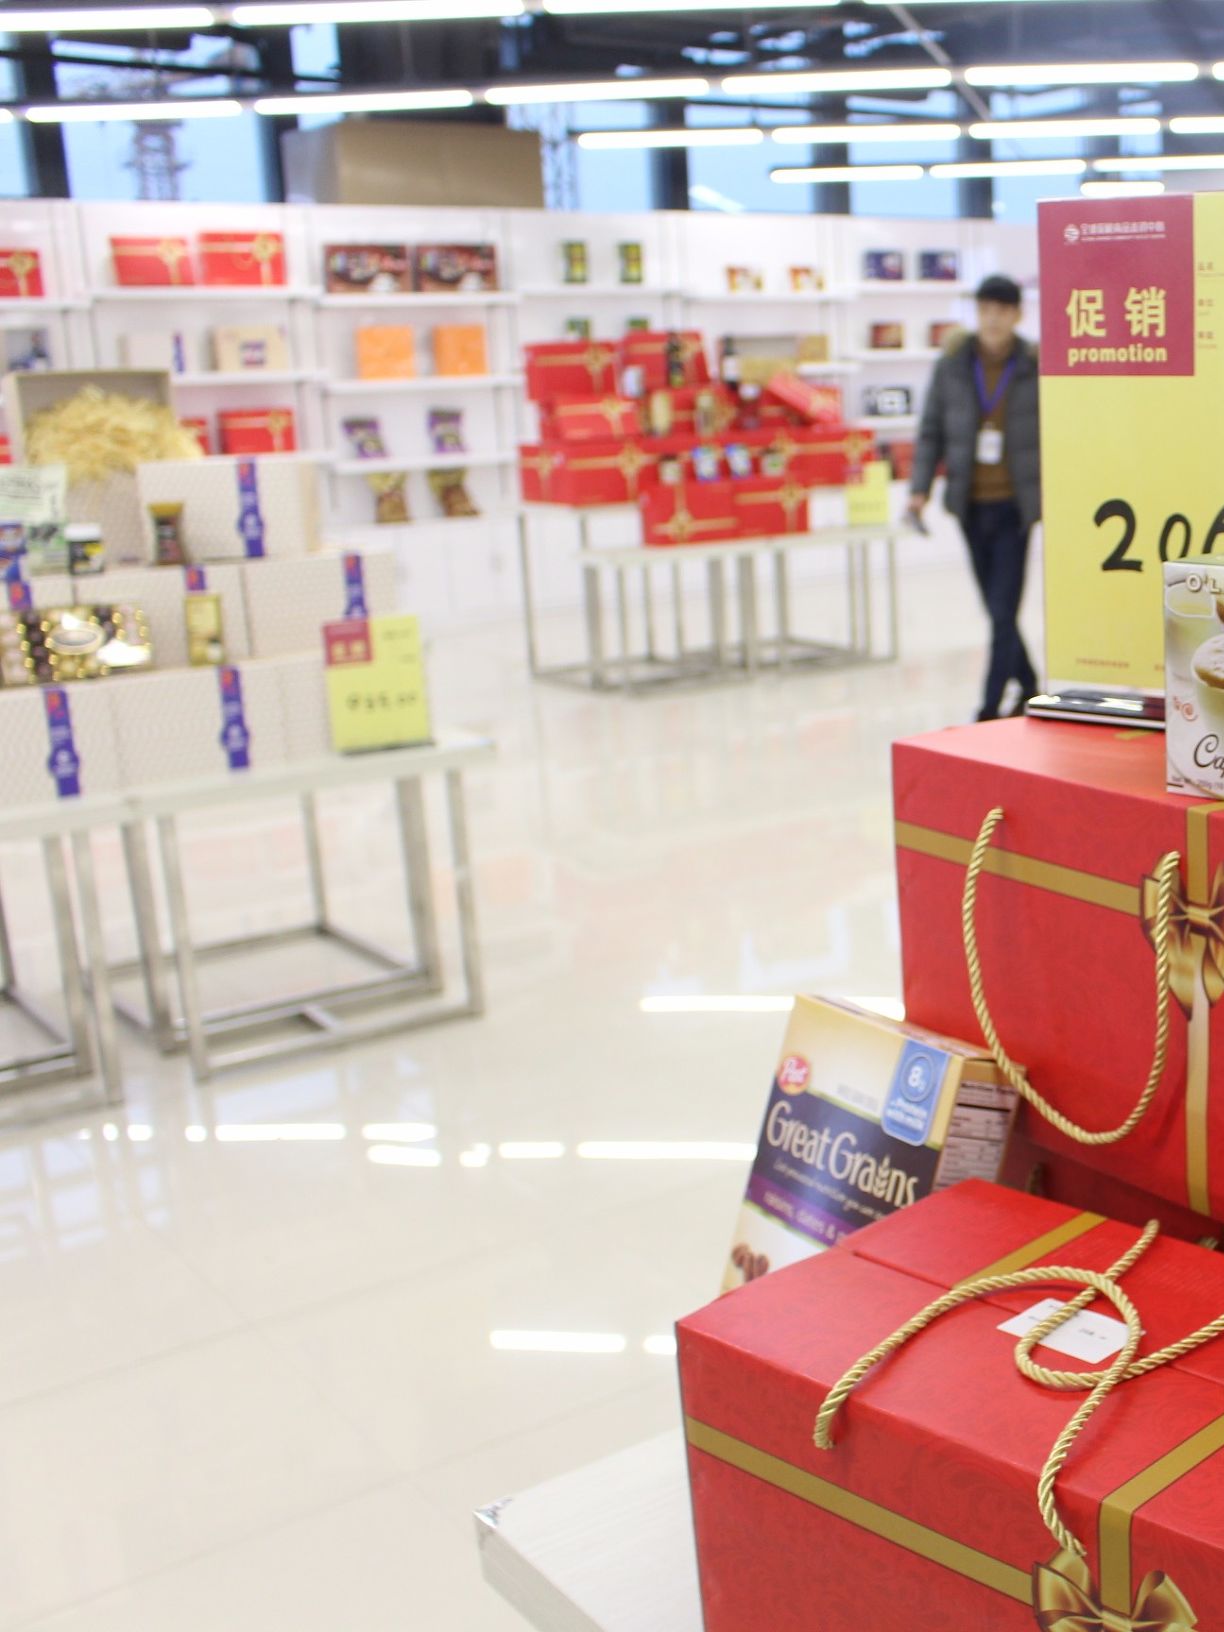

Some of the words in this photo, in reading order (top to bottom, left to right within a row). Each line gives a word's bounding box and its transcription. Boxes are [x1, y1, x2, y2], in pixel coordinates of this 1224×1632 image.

[1066, 286, 1168, 339] 促销
[1067, 342, 1168, 367] promotion
[766, 1100, 832, 1170] Great
